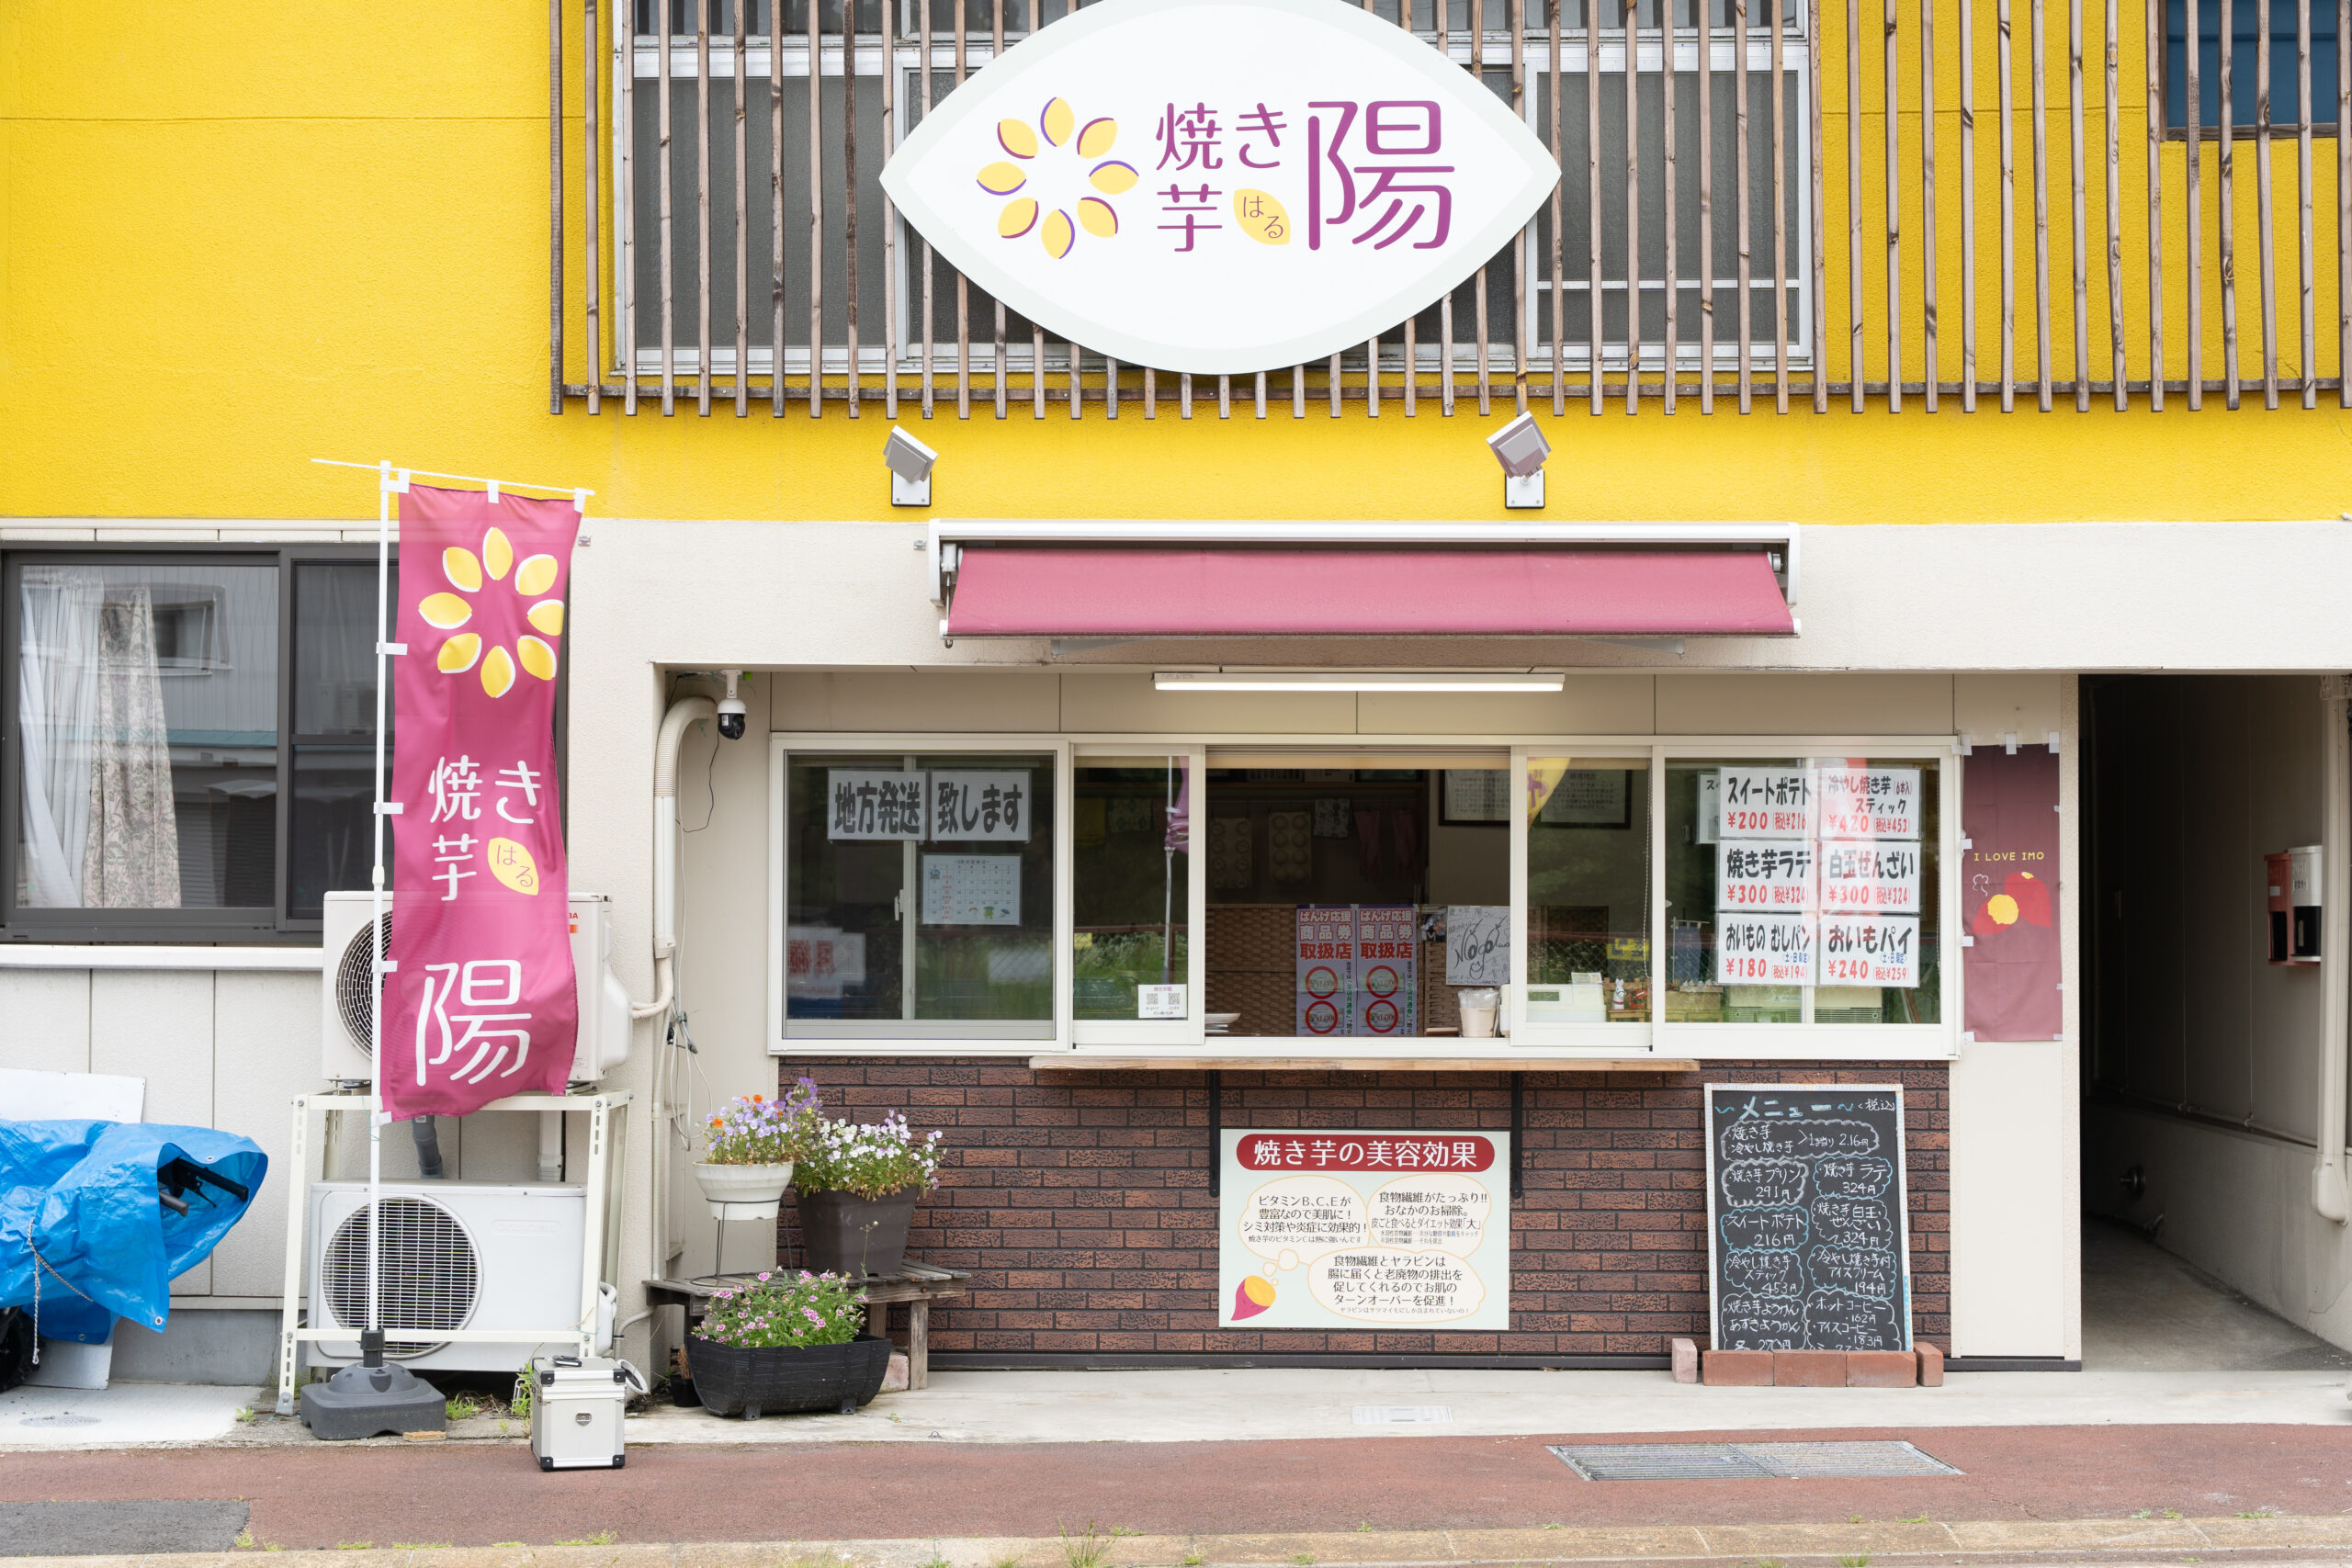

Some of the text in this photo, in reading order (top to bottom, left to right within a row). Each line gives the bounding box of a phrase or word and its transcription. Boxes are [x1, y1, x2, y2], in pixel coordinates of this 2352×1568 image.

[1156, 101, 1288, 172] 焼き
[1307, 99, 1456, 251] 陽
[1156, 183, 1223, 254] 芋
[1242, 194, 1284, 240] はる
[427, 754, 542, 824] 焼き
[1727, 776, 1812, 806] スイートポテト
[834, 781, 1023, 834] 地方発送 致します
[1855, 797, 1906, 815] スティック
[1727, 811, 1769, 830] ¥200
[1828, 814, 1870, 833] ¥420
[496, 844, 535, 887] はる
[1726, 848, 1812, 879] 焼き芋ラテ
[1829, 849, 1914, 880] 白玉ぜんざい
[1973, 852, 2045, 862] I LOVE IMO
[431, 833, 479, 901] 芋
[1727, 885, 1768, 904] ¥300
[1828, 885, 1870, 905] ¥300
[1725, 922, 1811, 953] おいもの むしパン
[1828, 924, 1913, 955] おいもパイ
[1299, 942, 1353, 961] 取扱店
[1360, 942, 1414, 960] 取扱店
[1725, 957, 1767, 978] ¥180
[1827, 959, 1869, 979] ¥240
[415, 959, 533, 1087] 陽
[1253, 1138, 1478, 1168] 焼き芋の美容効果
[1755, 1185, 1791, 1201] 291円
[1842, 1181, 1876, 1195] 324円
[1384, 1204, 1468, 1217] おなかのお掃除。
[1727, 1213, 1804, 1231] スイートポテト
[1829, 1216, 1882, 1231] ぜんざい
[1754, 1233, 1795, 1247] 216円
[1842, 1230, 1880, 1246] 324円
[1328, 1268, 1463, 1280] 腸に届くと老廃物の排出を
[1744, 1269, 1787, 1282] スティック
[1827, 1266, 1885, 1281] アイスクリーム
[1333, 1280, 1457, 1293] 促してくれるのでお肌の
[1761, 1281, 1798, 1294] 453円
[1855, 1280, 1886, 1295] 194円
[1851, 1314, 1876, 1324] 162円
[1854, 1335, 1883, 1348] 183円
